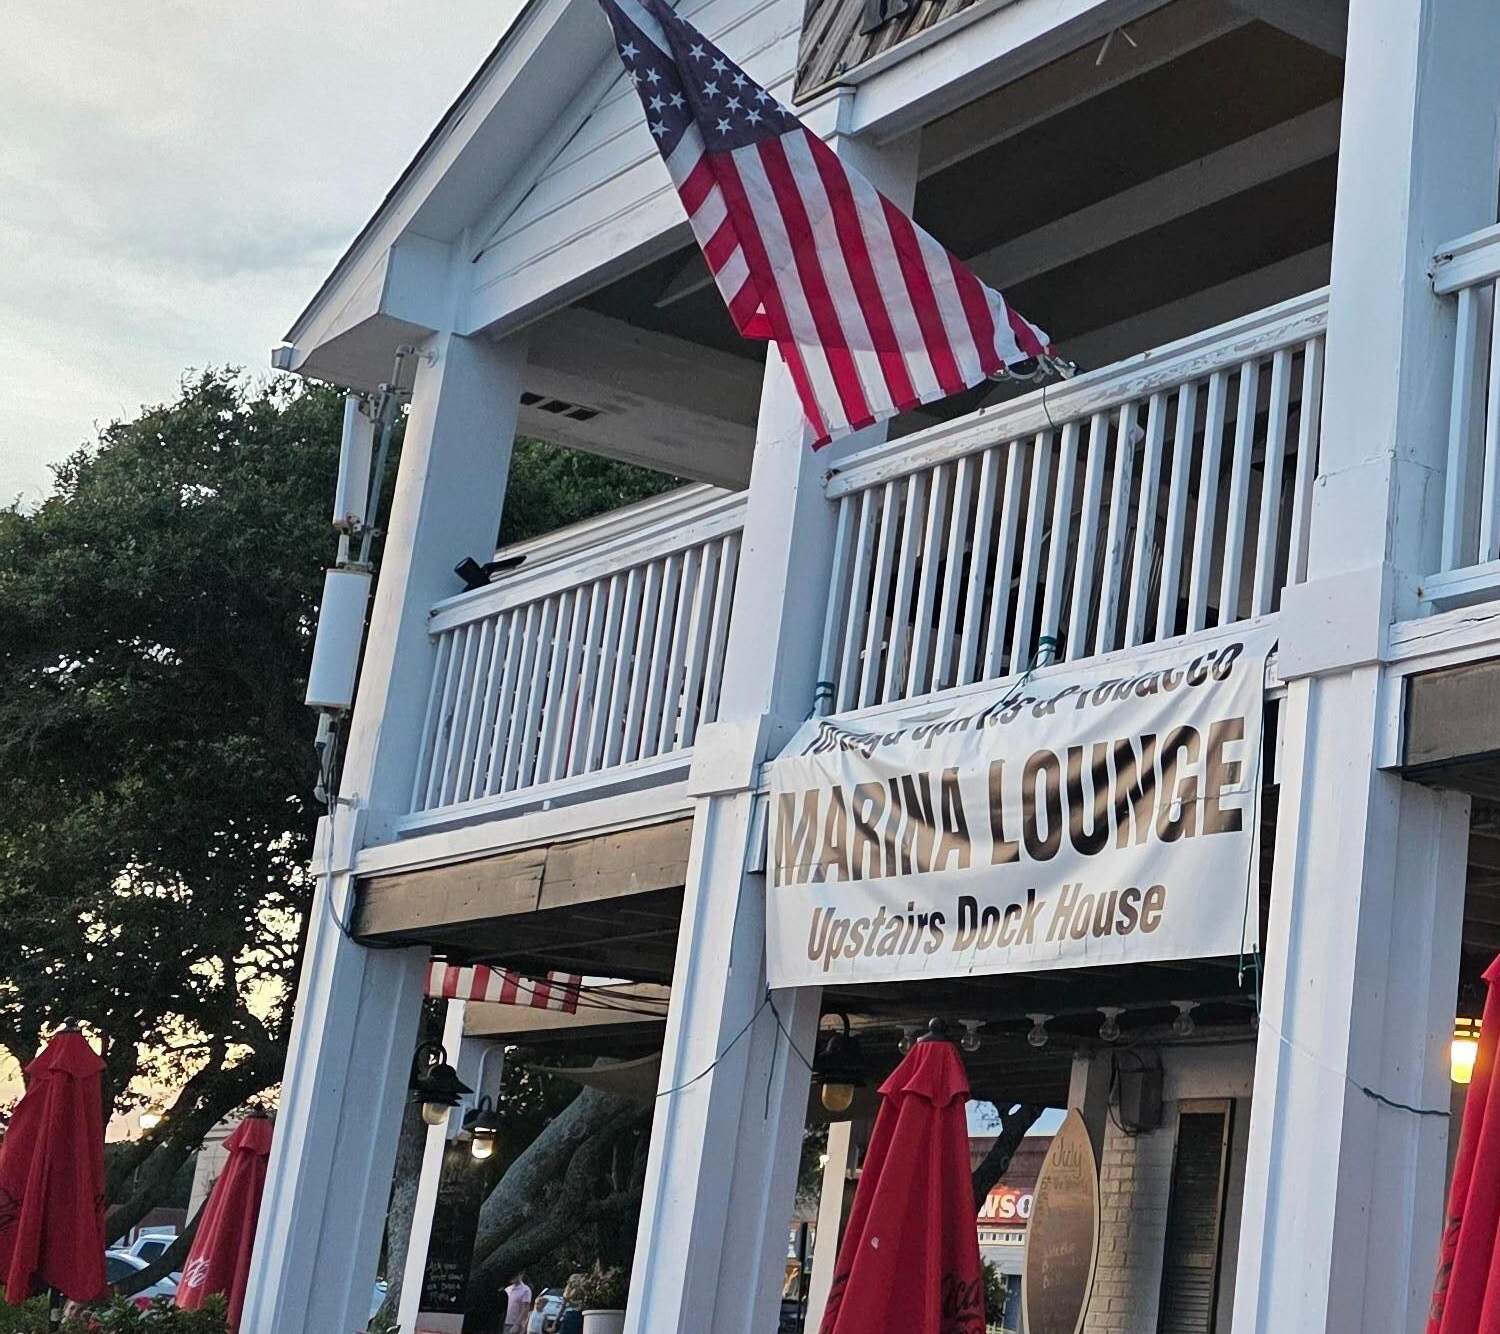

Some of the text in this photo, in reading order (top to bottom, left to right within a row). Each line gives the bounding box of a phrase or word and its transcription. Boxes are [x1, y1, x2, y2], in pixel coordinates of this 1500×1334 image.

[774, 716, 1245, 888] MARINA LOUNGE
[807, 882, 1166, 973] Upstairs Dock House
